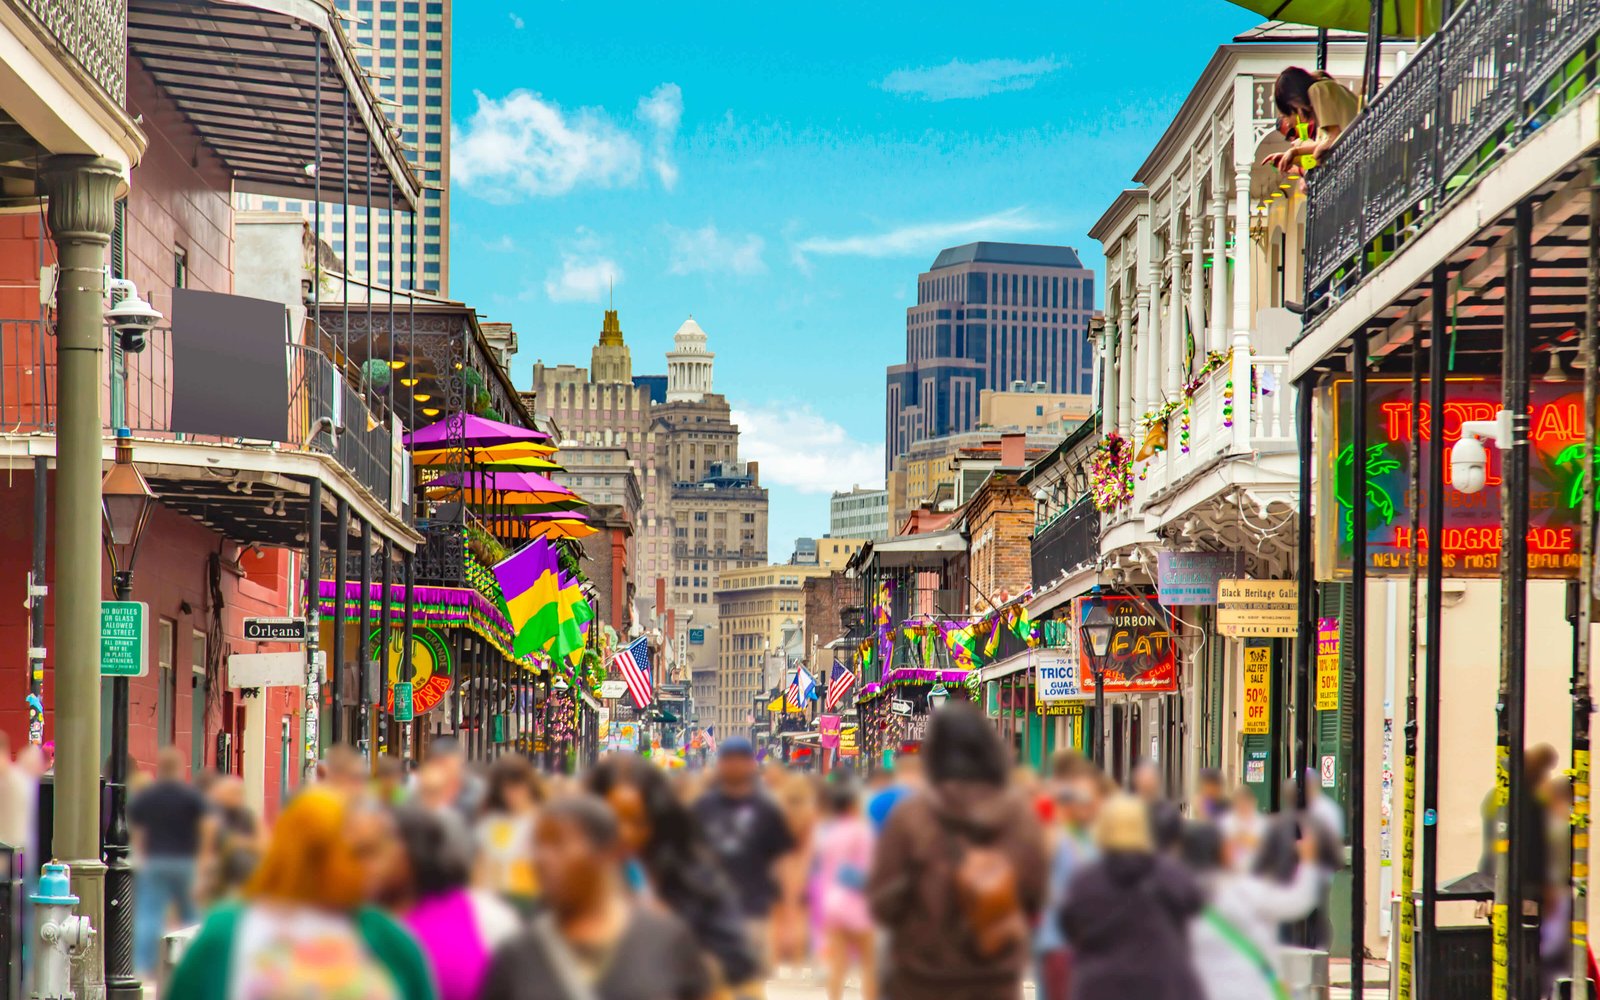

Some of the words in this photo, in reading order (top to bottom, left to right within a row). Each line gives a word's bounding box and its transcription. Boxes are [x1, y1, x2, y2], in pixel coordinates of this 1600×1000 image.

[1382, 402, 1587, 442] TROPAL
[1396, 527, 1572, 550] HADGREADE
[1373, 553, 1400, 568] NEW
[1464, 553, 1498, 568] MOST
[1221, 588, 1241, 598] Black
[1244, 588, 1276, 600] Heritage
[1278, 588, 1298, 598] Galle
[111, 607, 138, 615] BOTTLES
[1120, 606, 1133, 615] 711
[104, 614, 113, 622] OR
[1112, 615, 1156, 627] URBON
[249, 624, 300, 637] Orleans
[1112, 630, 1170, 662] EAT
[1319, 641, 1340, 654] SALE
[1040, 666, 1073, 679] TRICO
[1105, 670, 1126, 679] RILL
[1148, 663, 1172, 678] CLUB
[1246, 663, 1257, 673] JAZZ
[1257, 663, 1268, 673] FEST
[1250, 674, 1264, 684] SALE
[1321, 676, 1338, 689] 50%
[1246, 688, 1268, 703] 50%
[1320, 691, 1338, 699] SELECTE
[1037, 706, 1083, 716] CGARETTES
[1249, 705, 1264, 718] OFF
